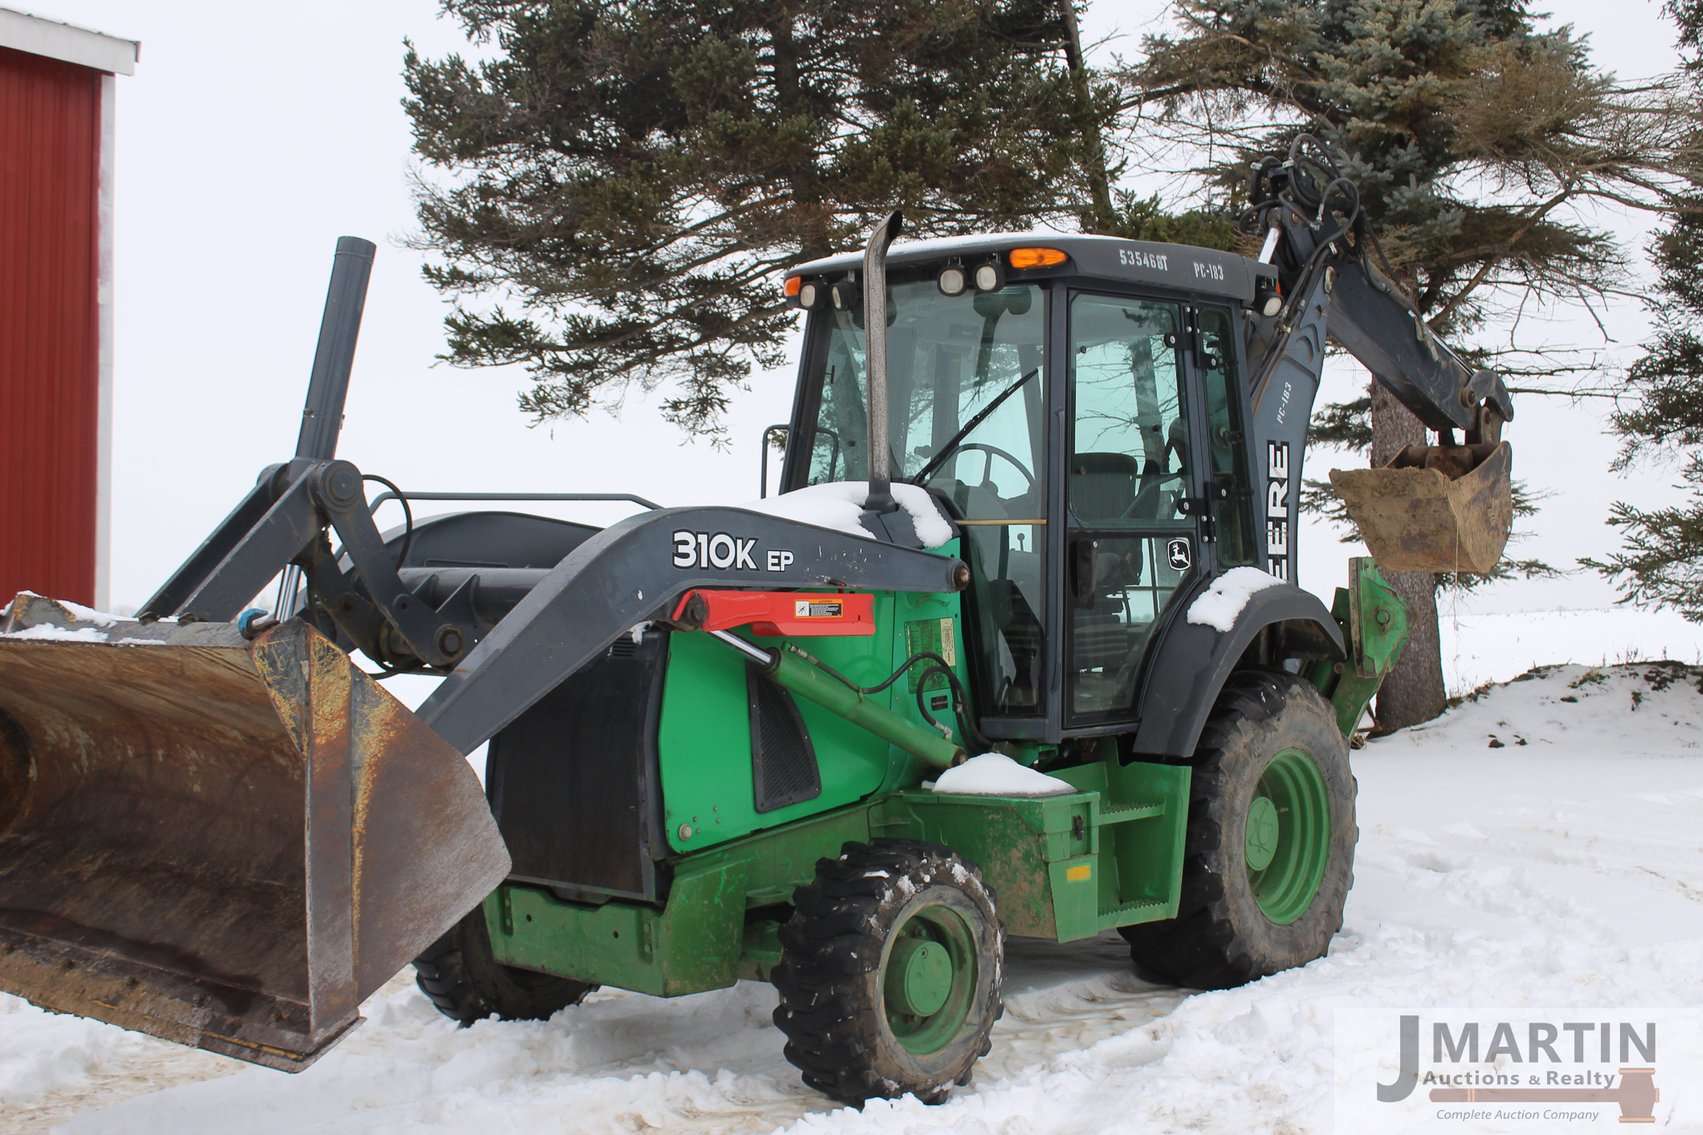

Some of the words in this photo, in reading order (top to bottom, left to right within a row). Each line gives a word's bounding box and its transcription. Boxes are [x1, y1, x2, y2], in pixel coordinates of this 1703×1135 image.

[1193, 261, 1224, 281] PC-183
[1276, 381, 1293, 425] PC-183
[672, 529, 759, 571] 310K
[767, 549, 794, 572] EP
